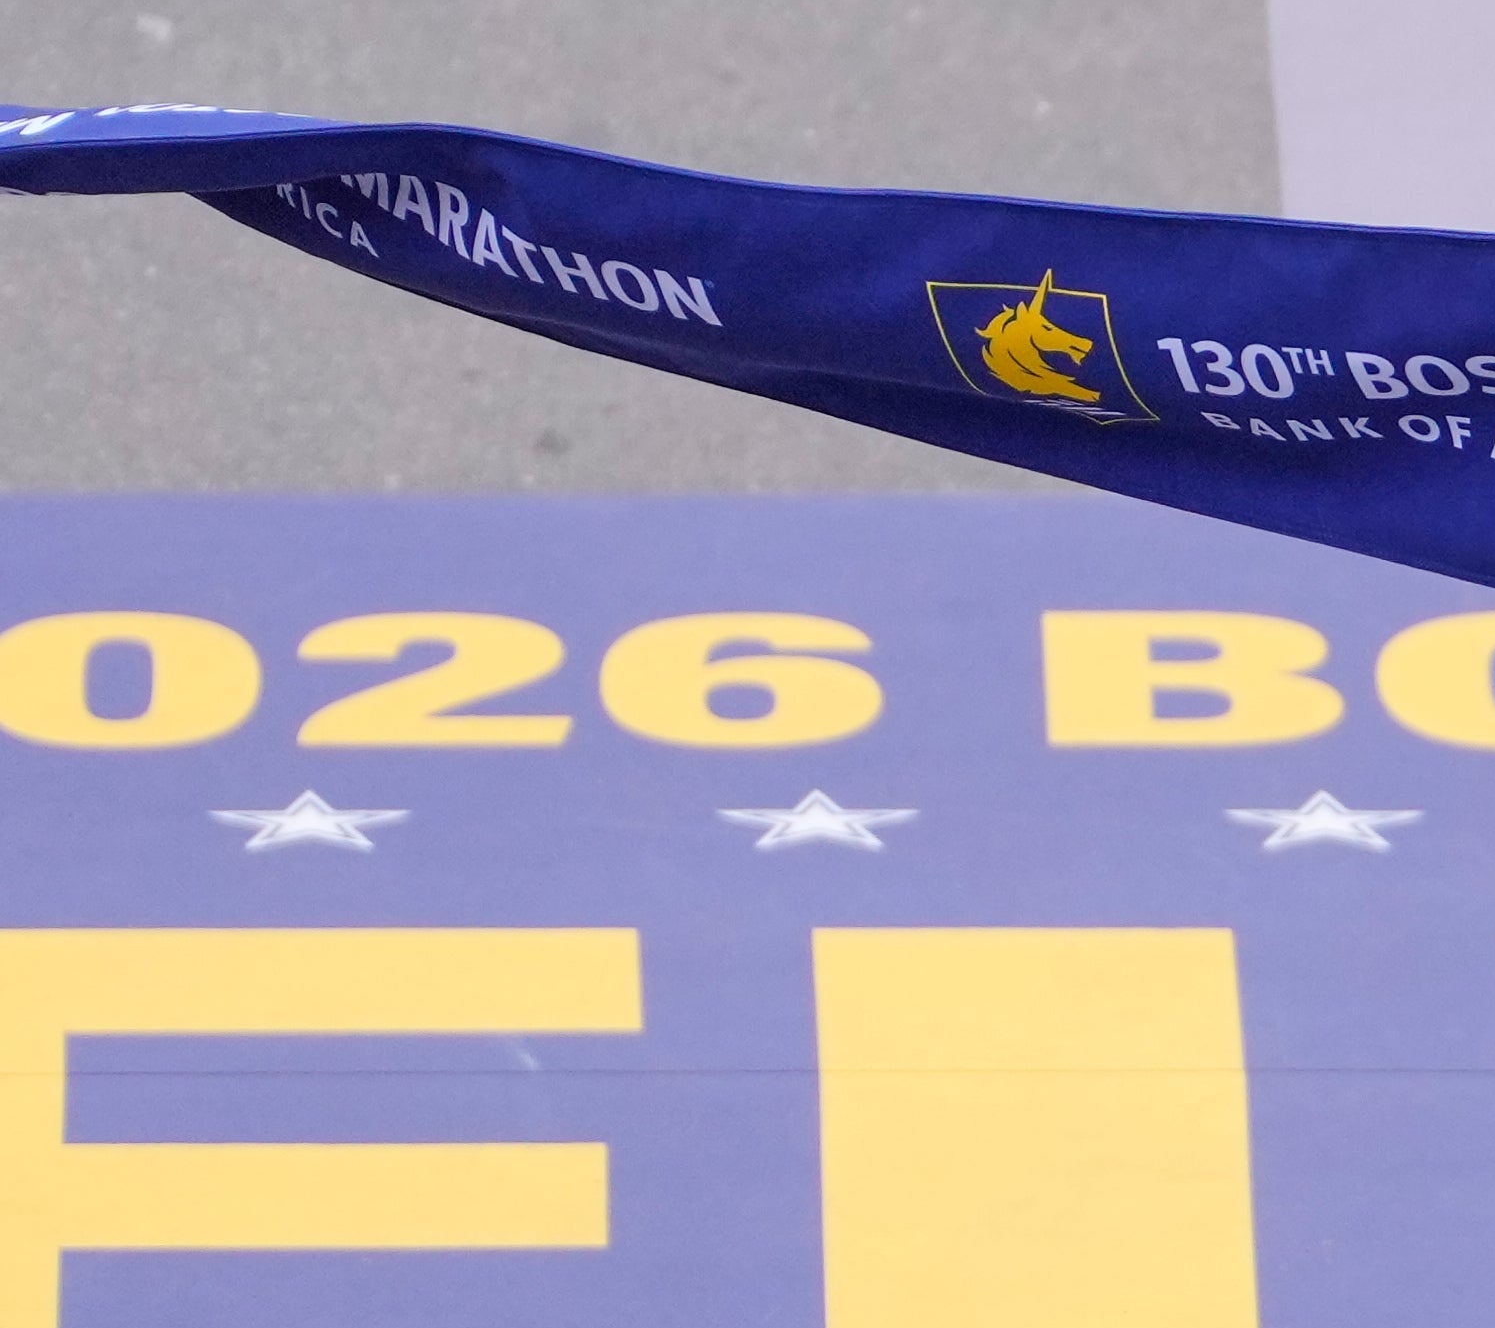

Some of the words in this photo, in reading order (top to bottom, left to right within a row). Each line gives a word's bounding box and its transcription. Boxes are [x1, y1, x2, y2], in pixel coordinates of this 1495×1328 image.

[1156, 337, 1335, 399] 130TH
[1200, 411, 1384, 442] BANK
[1398, 414, 1472, 450] OF
[0, 611, 884, 749] 026
